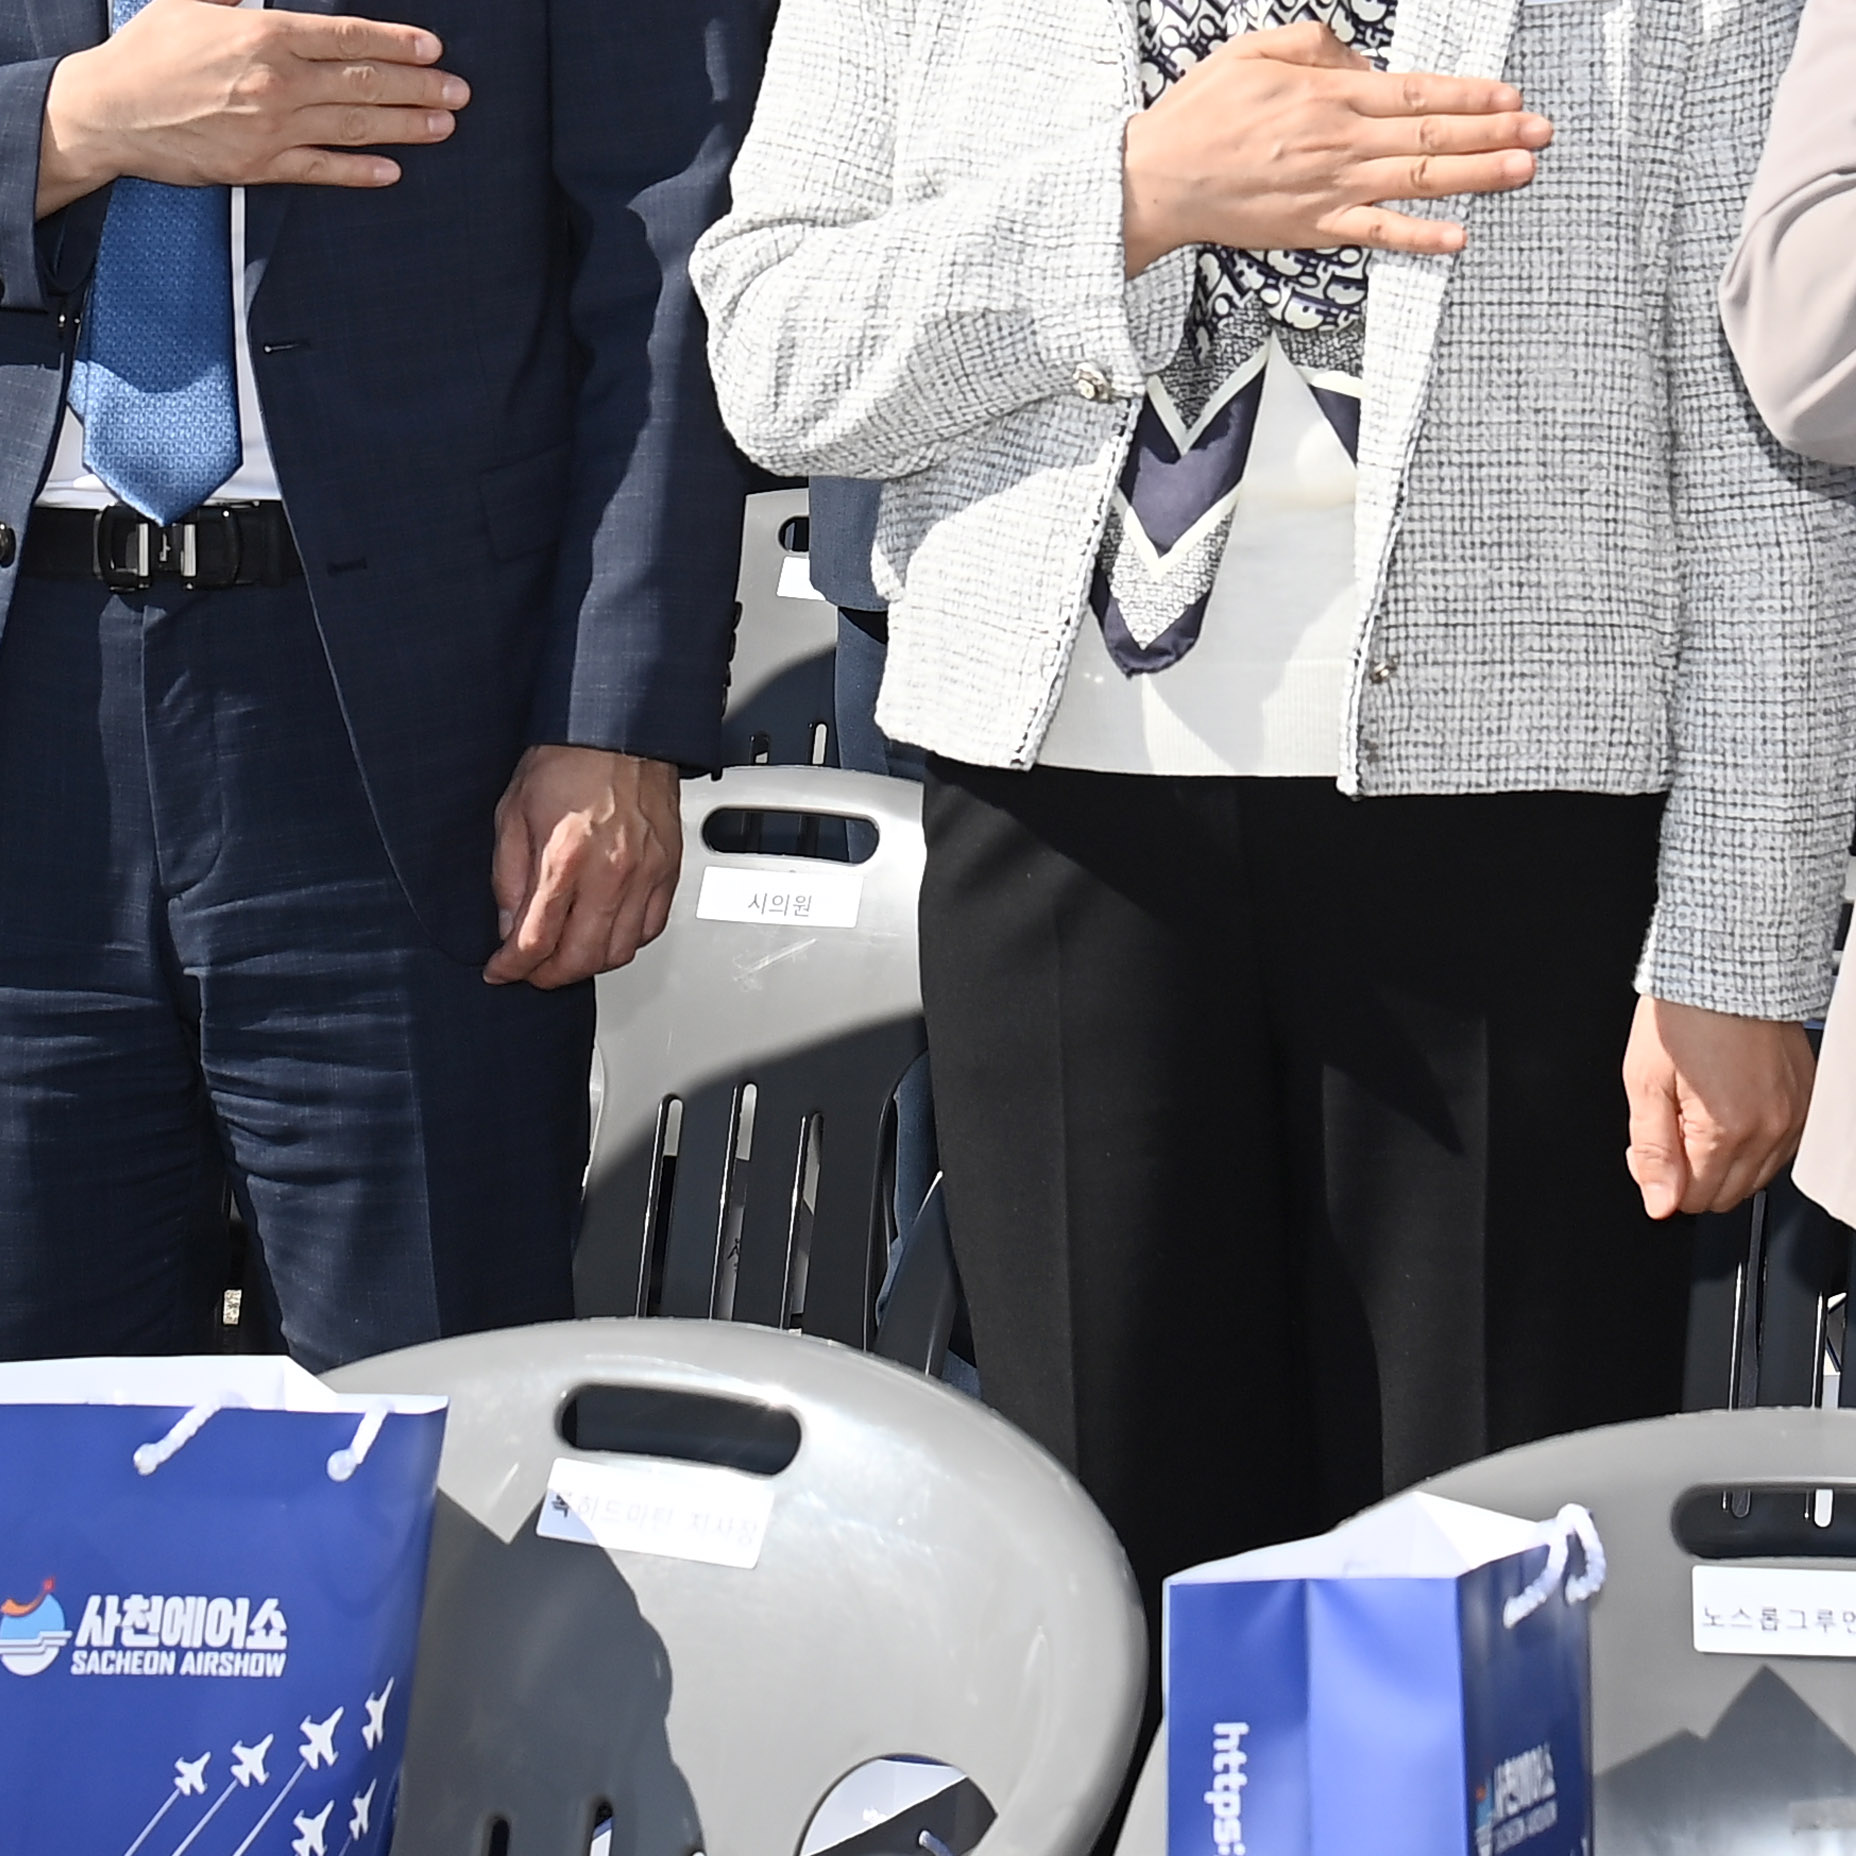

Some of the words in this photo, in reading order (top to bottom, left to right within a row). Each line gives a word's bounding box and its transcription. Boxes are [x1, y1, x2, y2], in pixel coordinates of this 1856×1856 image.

[748, 893, 812, 917] 시의원
[75, 1594, 288, 1650] 사천에어쇼
[70, 1650, 176, 1676] SACHEON
[179, 1652, 287, 1678] AIRSHOW
